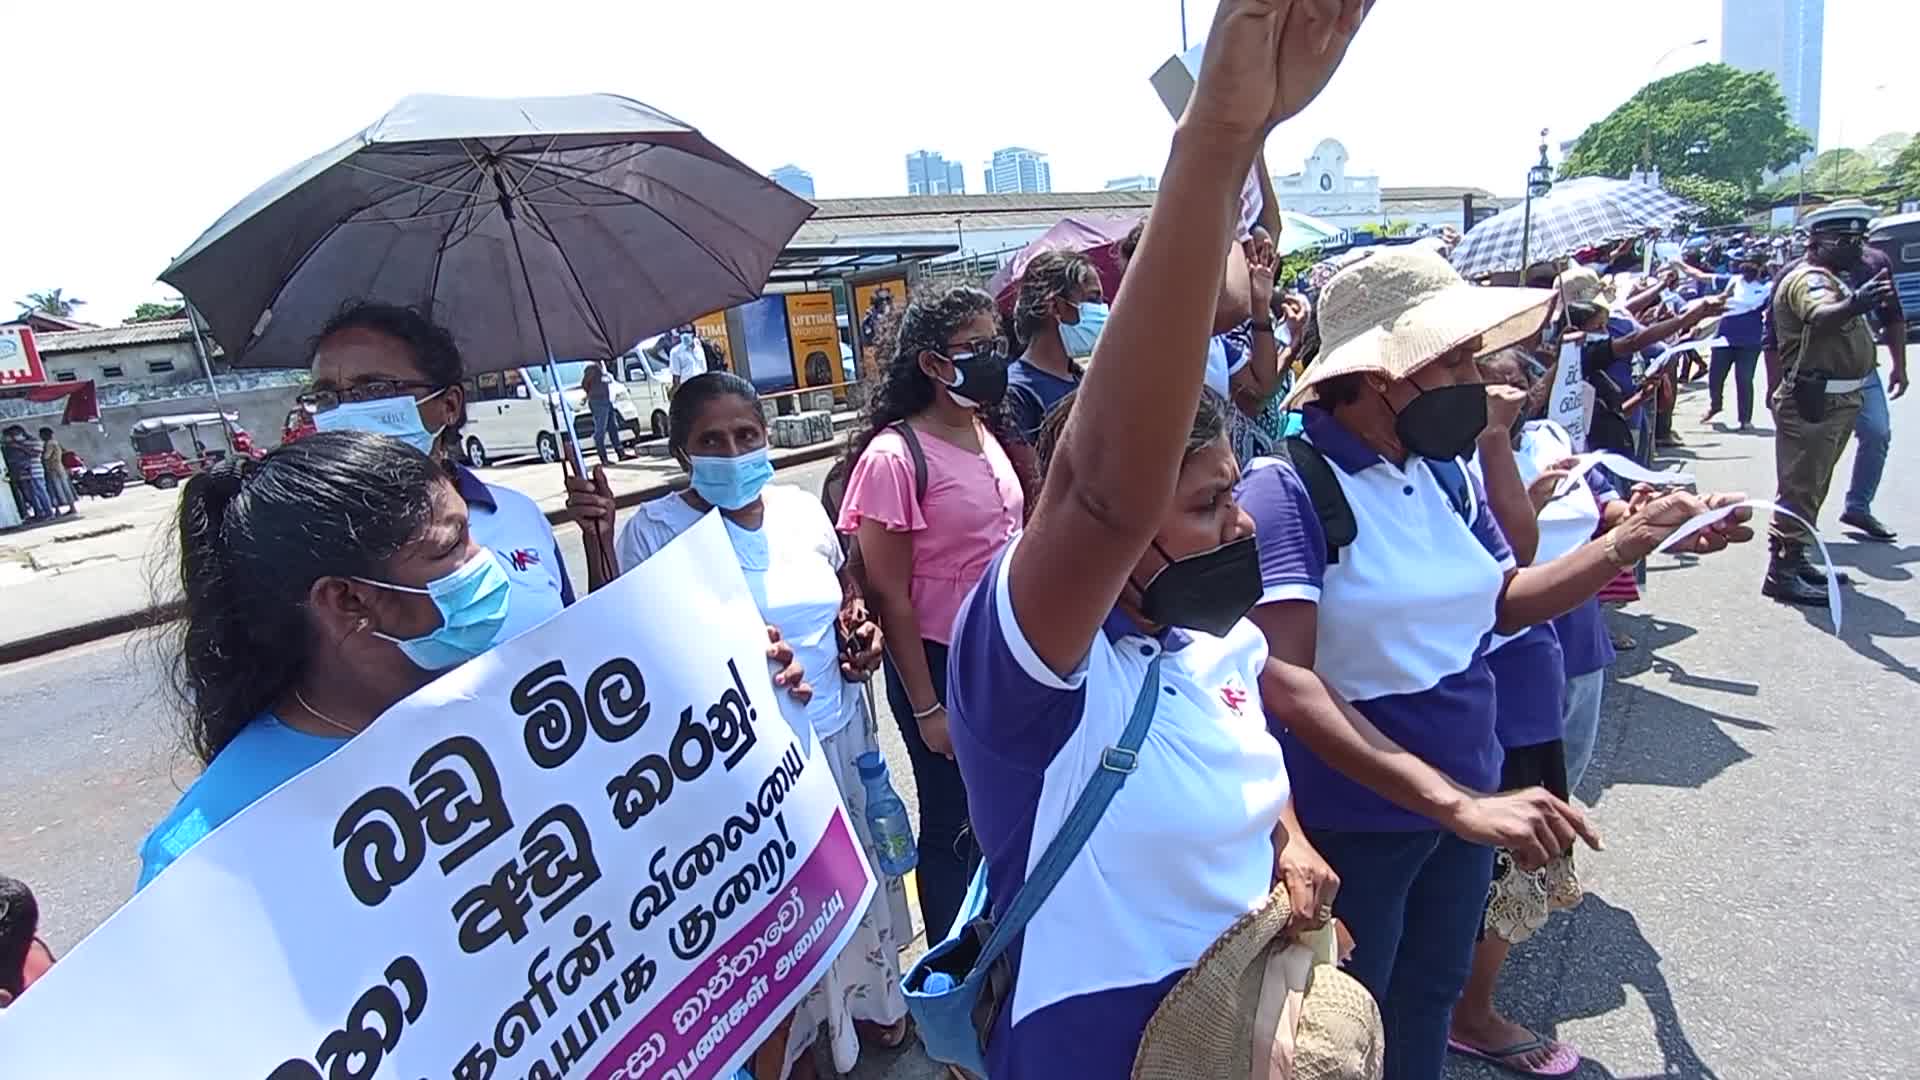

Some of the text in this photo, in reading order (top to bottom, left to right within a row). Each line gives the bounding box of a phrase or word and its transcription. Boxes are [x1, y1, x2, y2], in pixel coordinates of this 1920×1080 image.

[264, 658, 757, 1080] හා අඩු කරනු!
[333, 657, 651, 907] බඩු මිල
[417, 742, 805, 1080] களின் விலையை
[668, 810, 797, 961] குறை!
[671, 886, 806, 1035] කාන්තාවෝ
[772, 889, 846, 983] அமைப்பு
